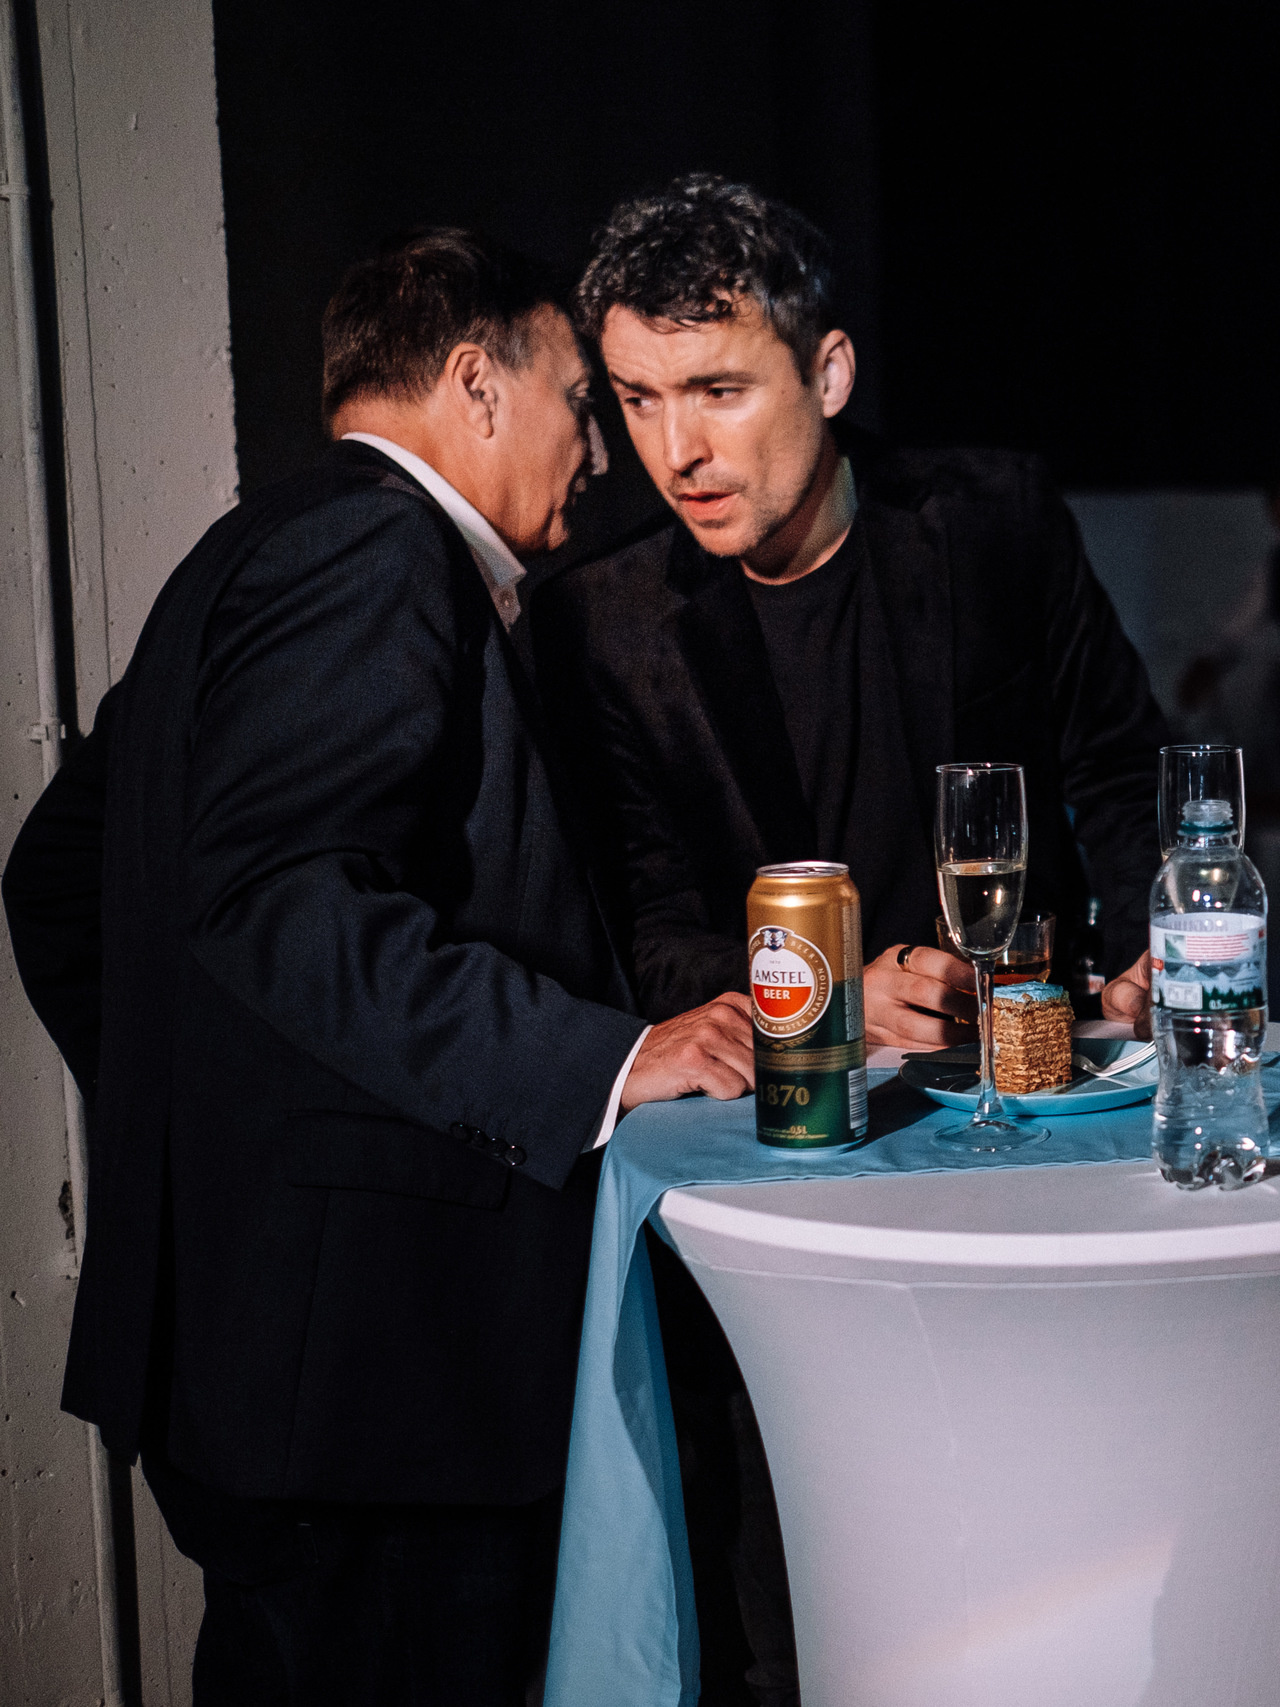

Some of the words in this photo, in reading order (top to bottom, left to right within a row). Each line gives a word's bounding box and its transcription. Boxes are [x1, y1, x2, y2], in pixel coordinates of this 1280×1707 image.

[754, 969, 806, 984] AMSTEL
[763, 988, 791, 1000] BEER
[772, 1018, 808, 1032] AMSTEL
[808, 968, 827, 1017] TRADITION
[760, 1084, 810, 1107] 1870
